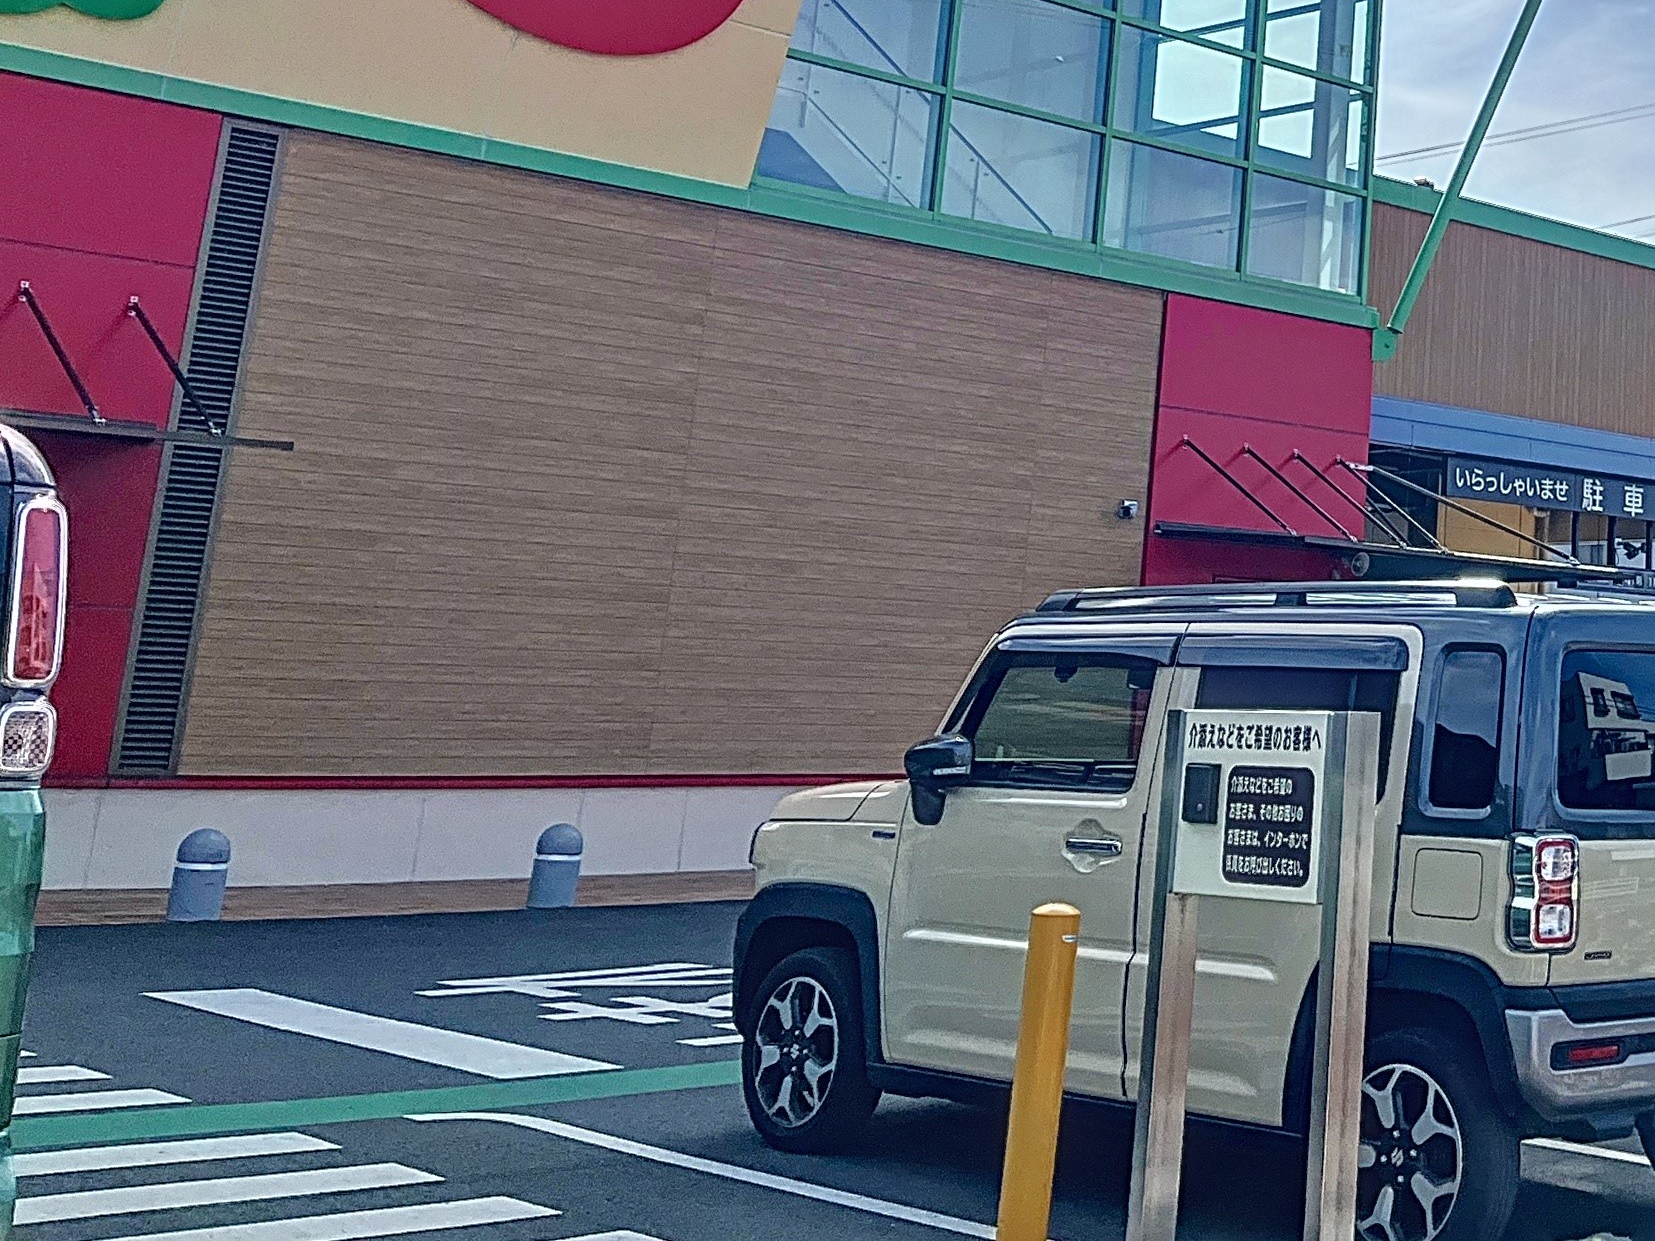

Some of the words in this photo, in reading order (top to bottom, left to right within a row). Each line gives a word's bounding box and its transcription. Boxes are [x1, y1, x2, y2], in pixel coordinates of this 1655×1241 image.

[1456, 467, 1568, 502] いらっしゃいませ
